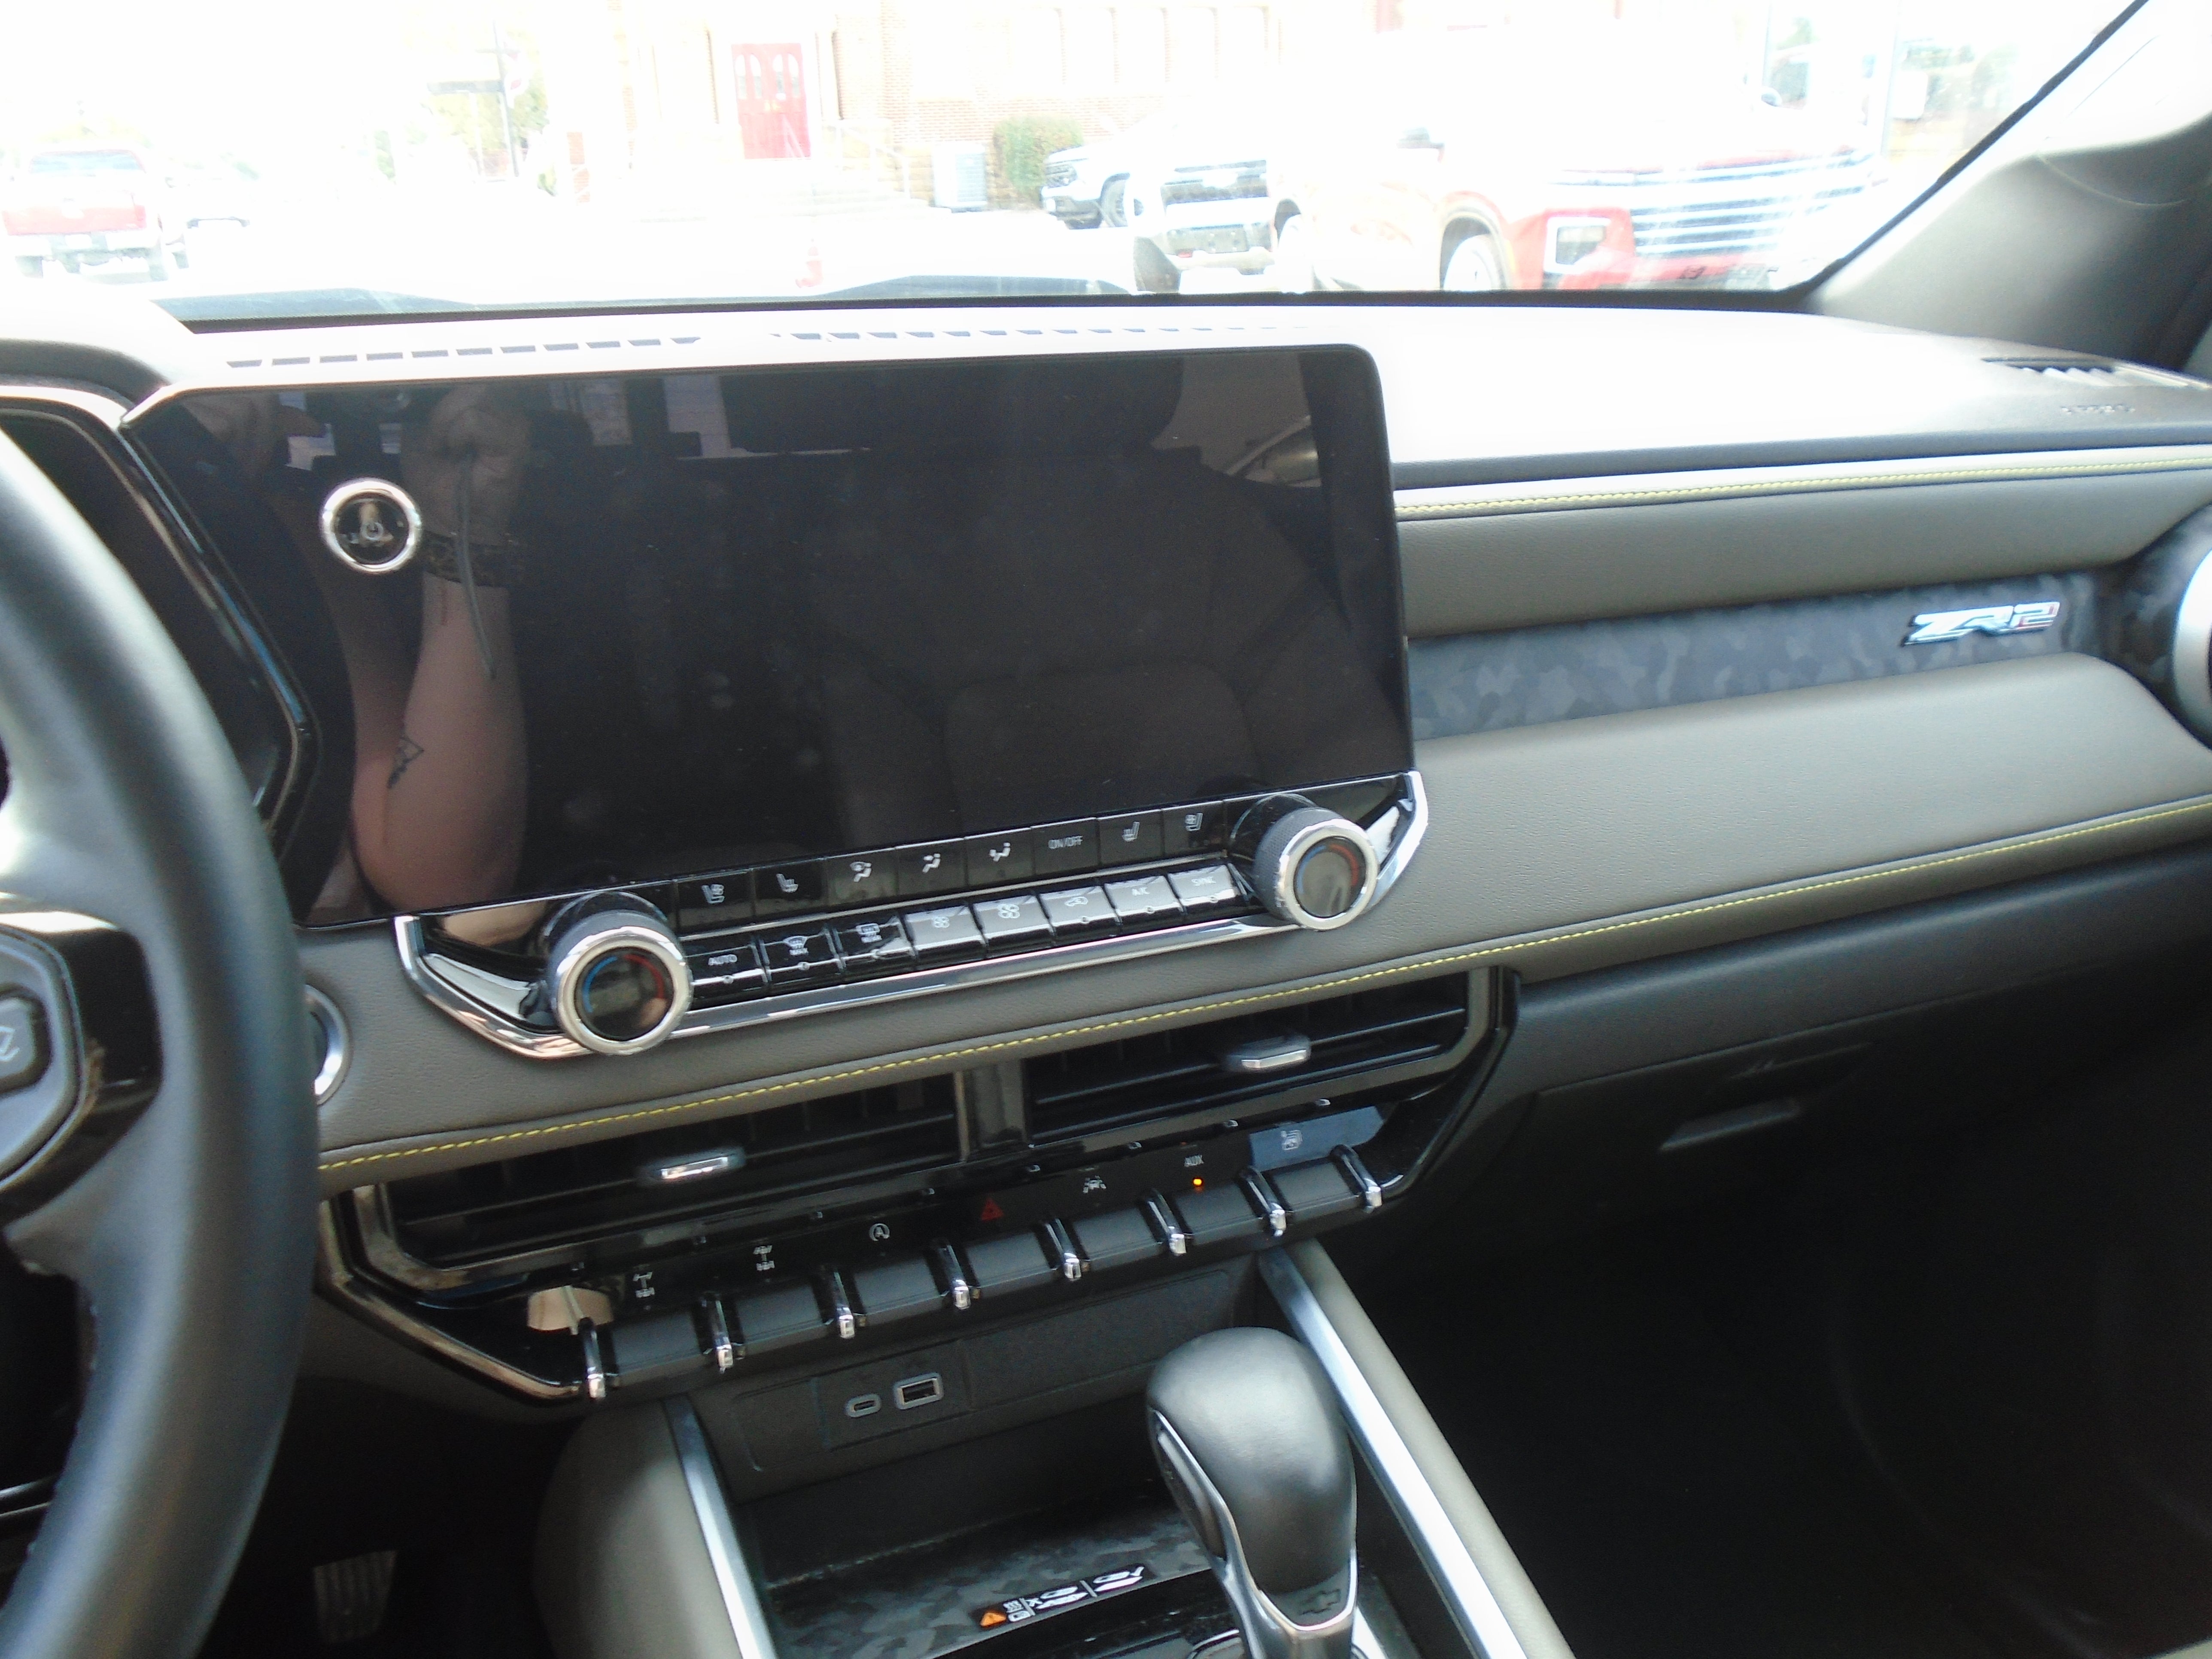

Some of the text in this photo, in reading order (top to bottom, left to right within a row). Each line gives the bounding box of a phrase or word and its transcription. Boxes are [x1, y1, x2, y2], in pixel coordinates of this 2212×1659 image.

[1903, 601, 2060, 645] ZR2
[1048, 836, 1083, 849] ON/OFF
[1191, 876, 1216, 886] SYNC
[1132, 887, 1150, 896] A/C
[708, 954, 738, 966] AUTO
[1184, 1155, 1204, 1167] AUX
